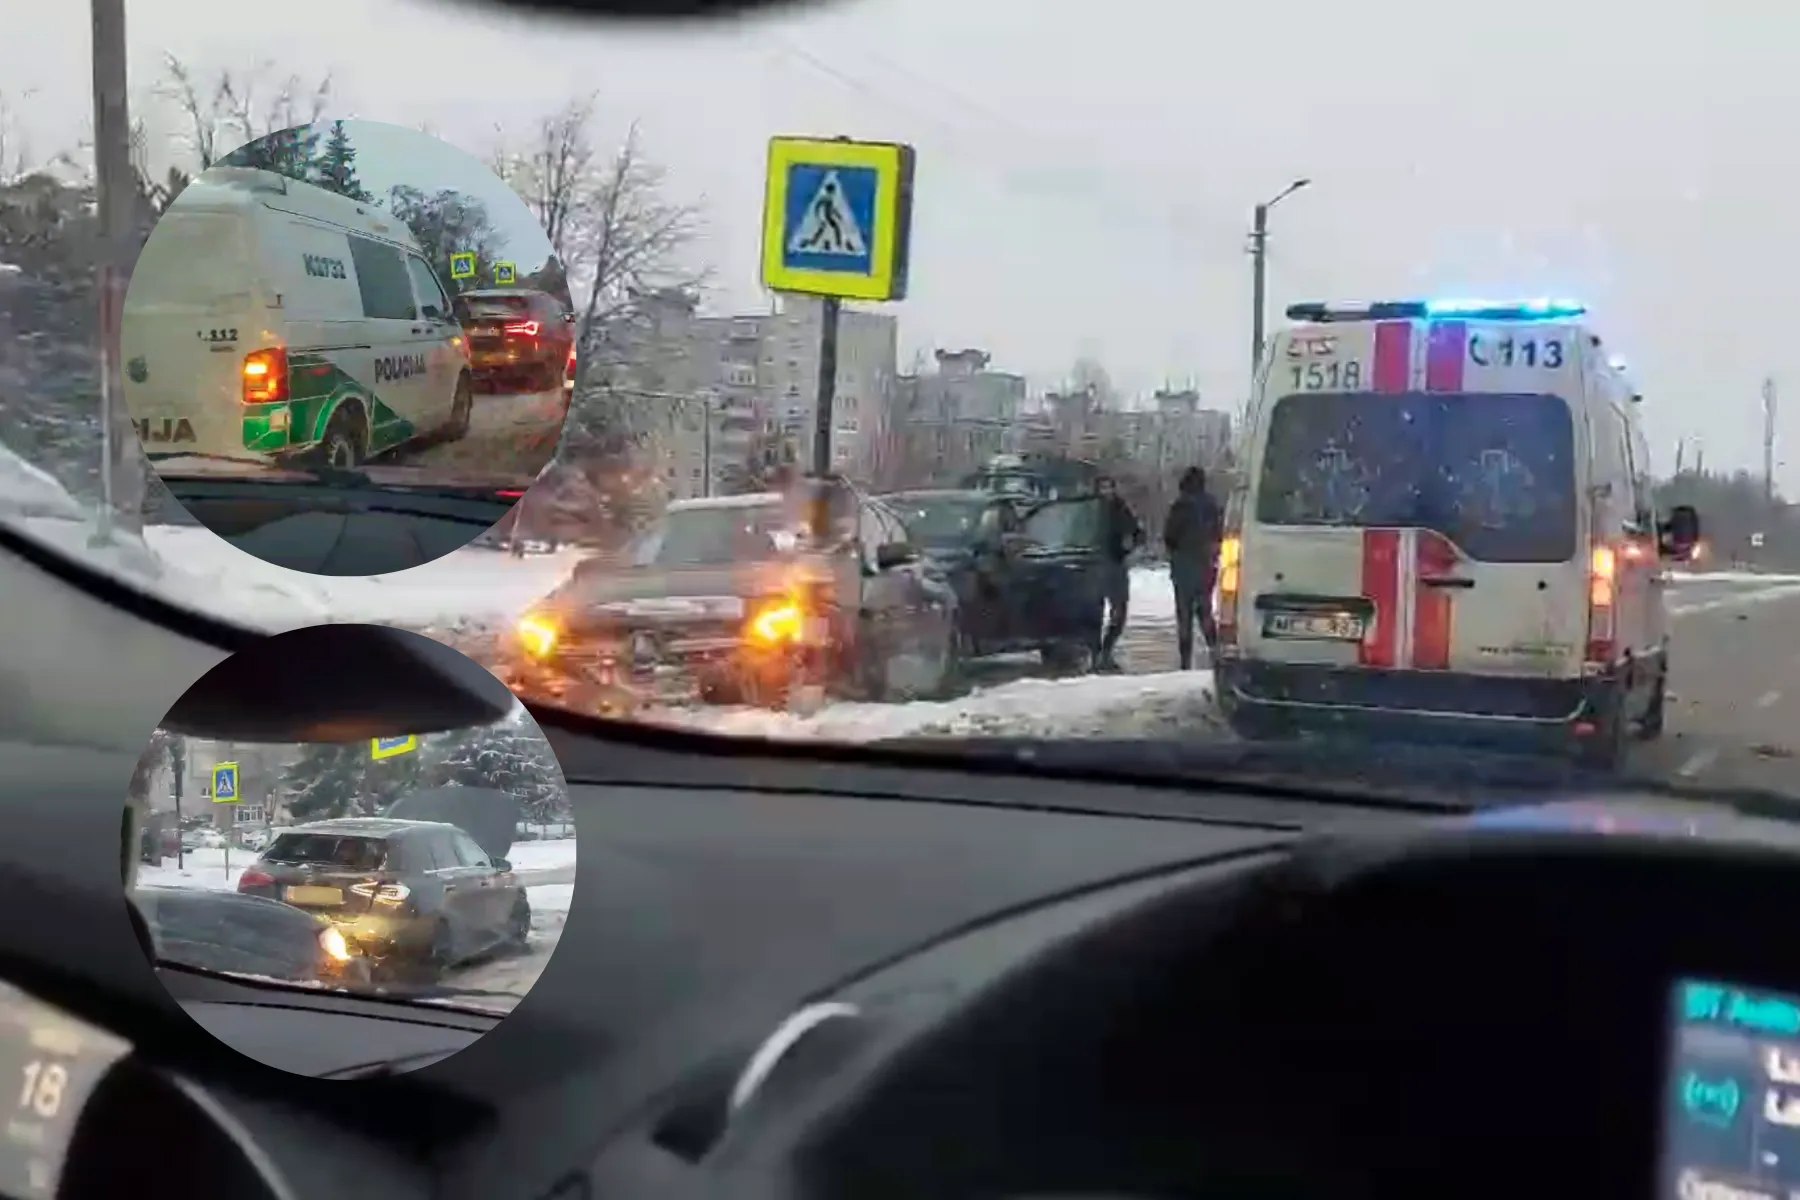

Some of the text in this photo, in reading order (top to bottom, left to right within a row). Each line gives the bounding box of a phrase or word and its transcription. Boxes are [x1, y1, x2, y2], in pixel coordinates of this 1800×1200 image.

[1498, 337, 1563, 369] 113
[1290, 361, 1360, 391] 1518
[20, 1061, 69, 1117] 18
